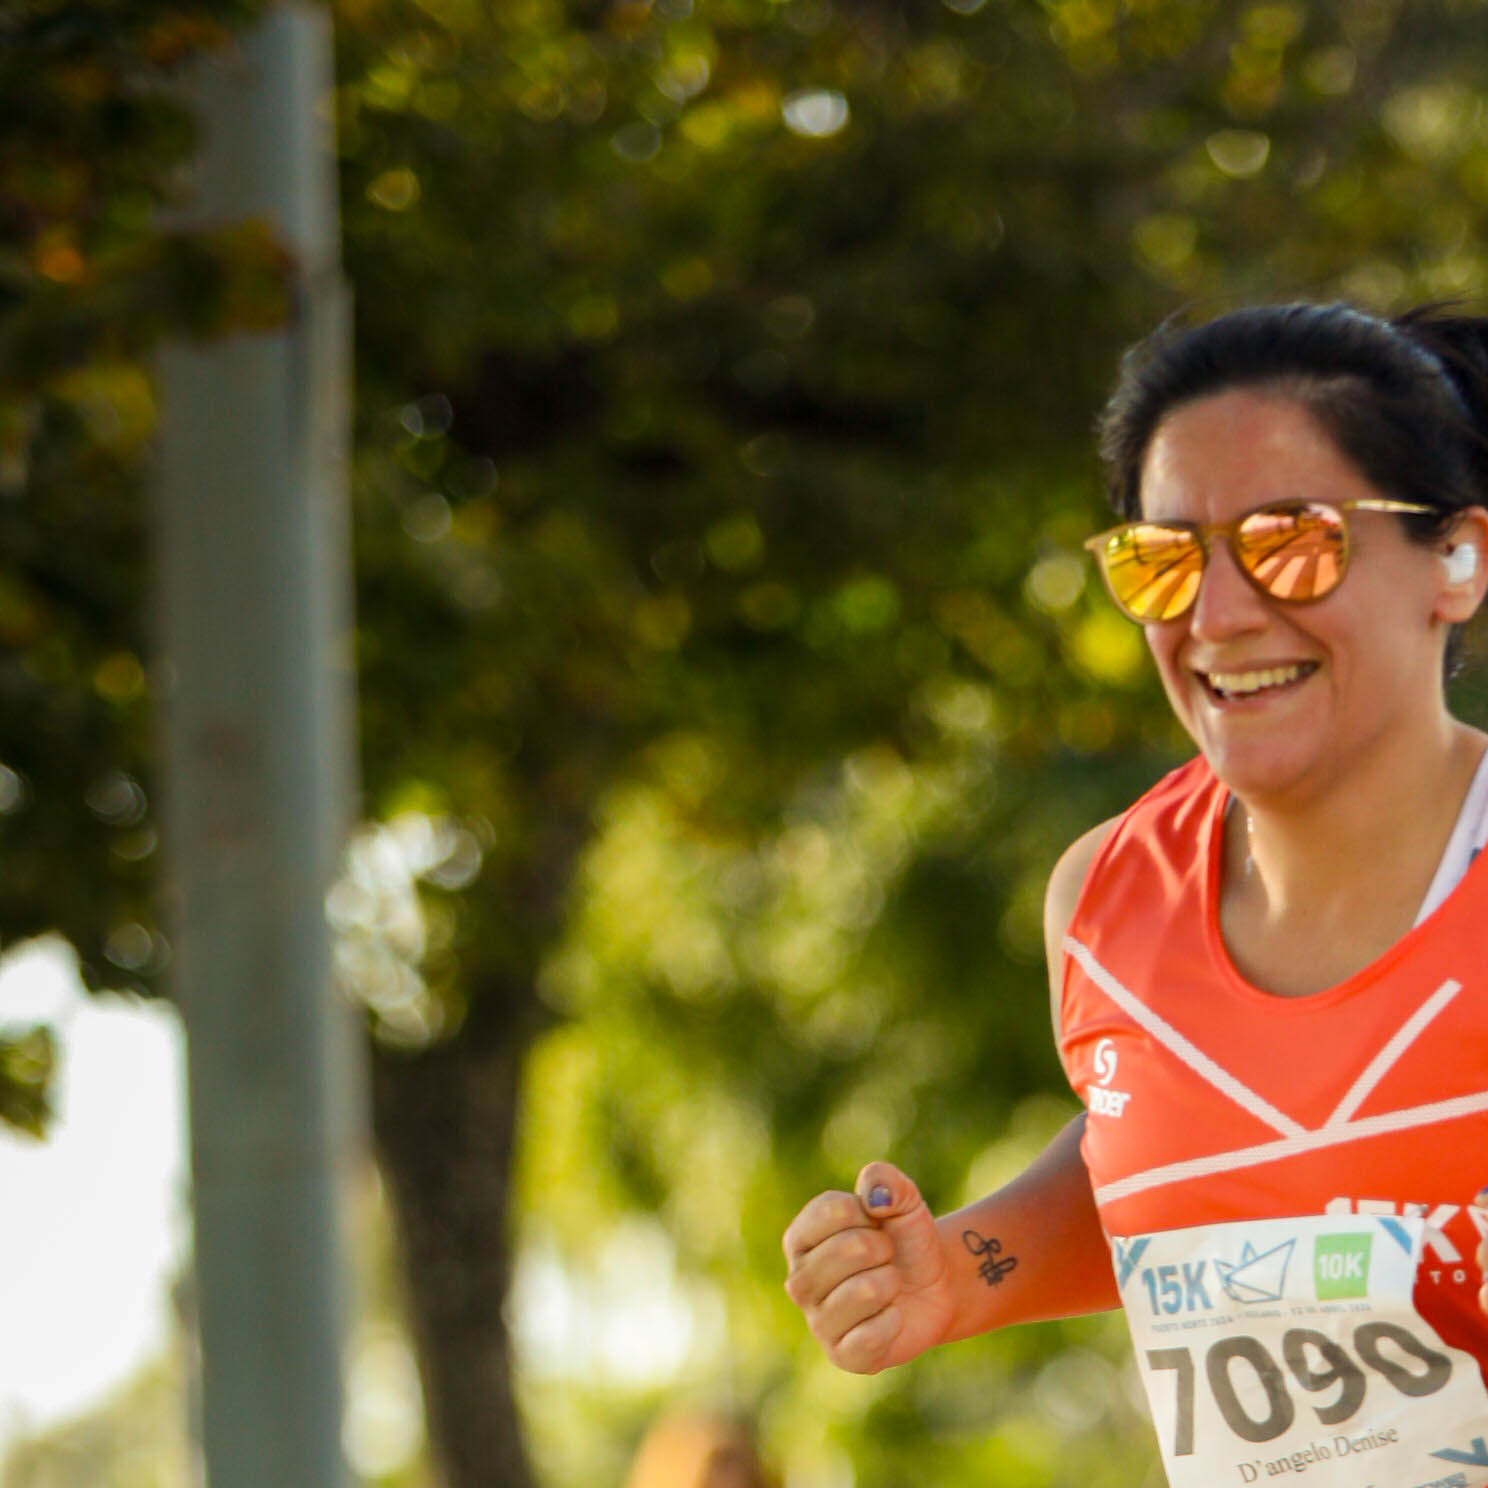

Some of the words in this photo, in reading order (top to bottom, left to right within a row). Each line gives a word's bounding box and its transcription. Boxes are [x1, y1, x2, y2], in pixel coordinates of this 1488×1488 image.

[1141, 1260, 1214, 1316] 15K
[1317, 1251, 1365, 1282] 10K
[1146, 1321, 1453, 1457] 7090
[1333, 1427, 1399, 1457] Denise
